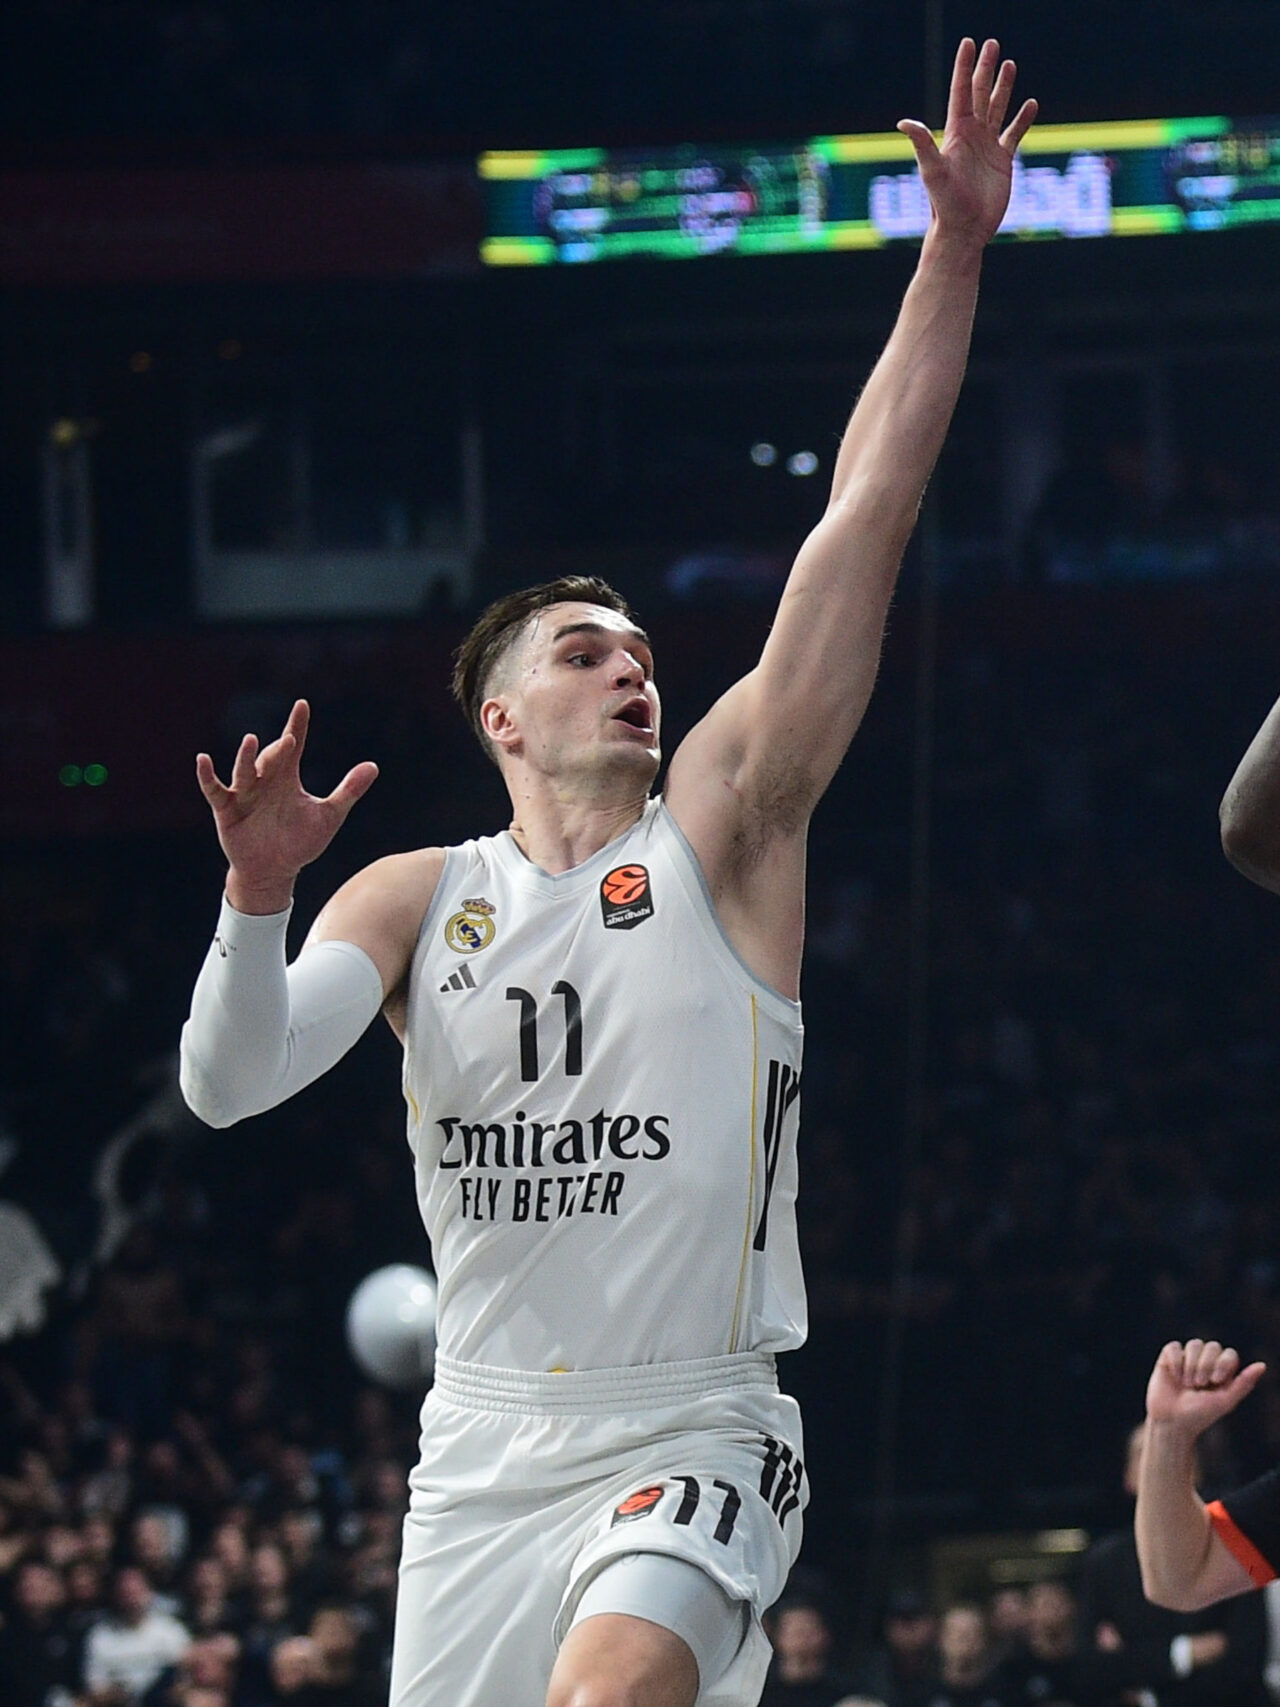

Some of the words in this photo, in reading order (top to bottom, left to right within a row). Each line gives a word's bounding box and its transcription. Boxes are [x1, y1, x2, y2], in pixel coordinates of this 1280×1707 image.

[435, 1107, 671, 1169] Emirates
[460, 1177, 502, 1221] FLY
[512, 1171, 625, 1222] BETTER
